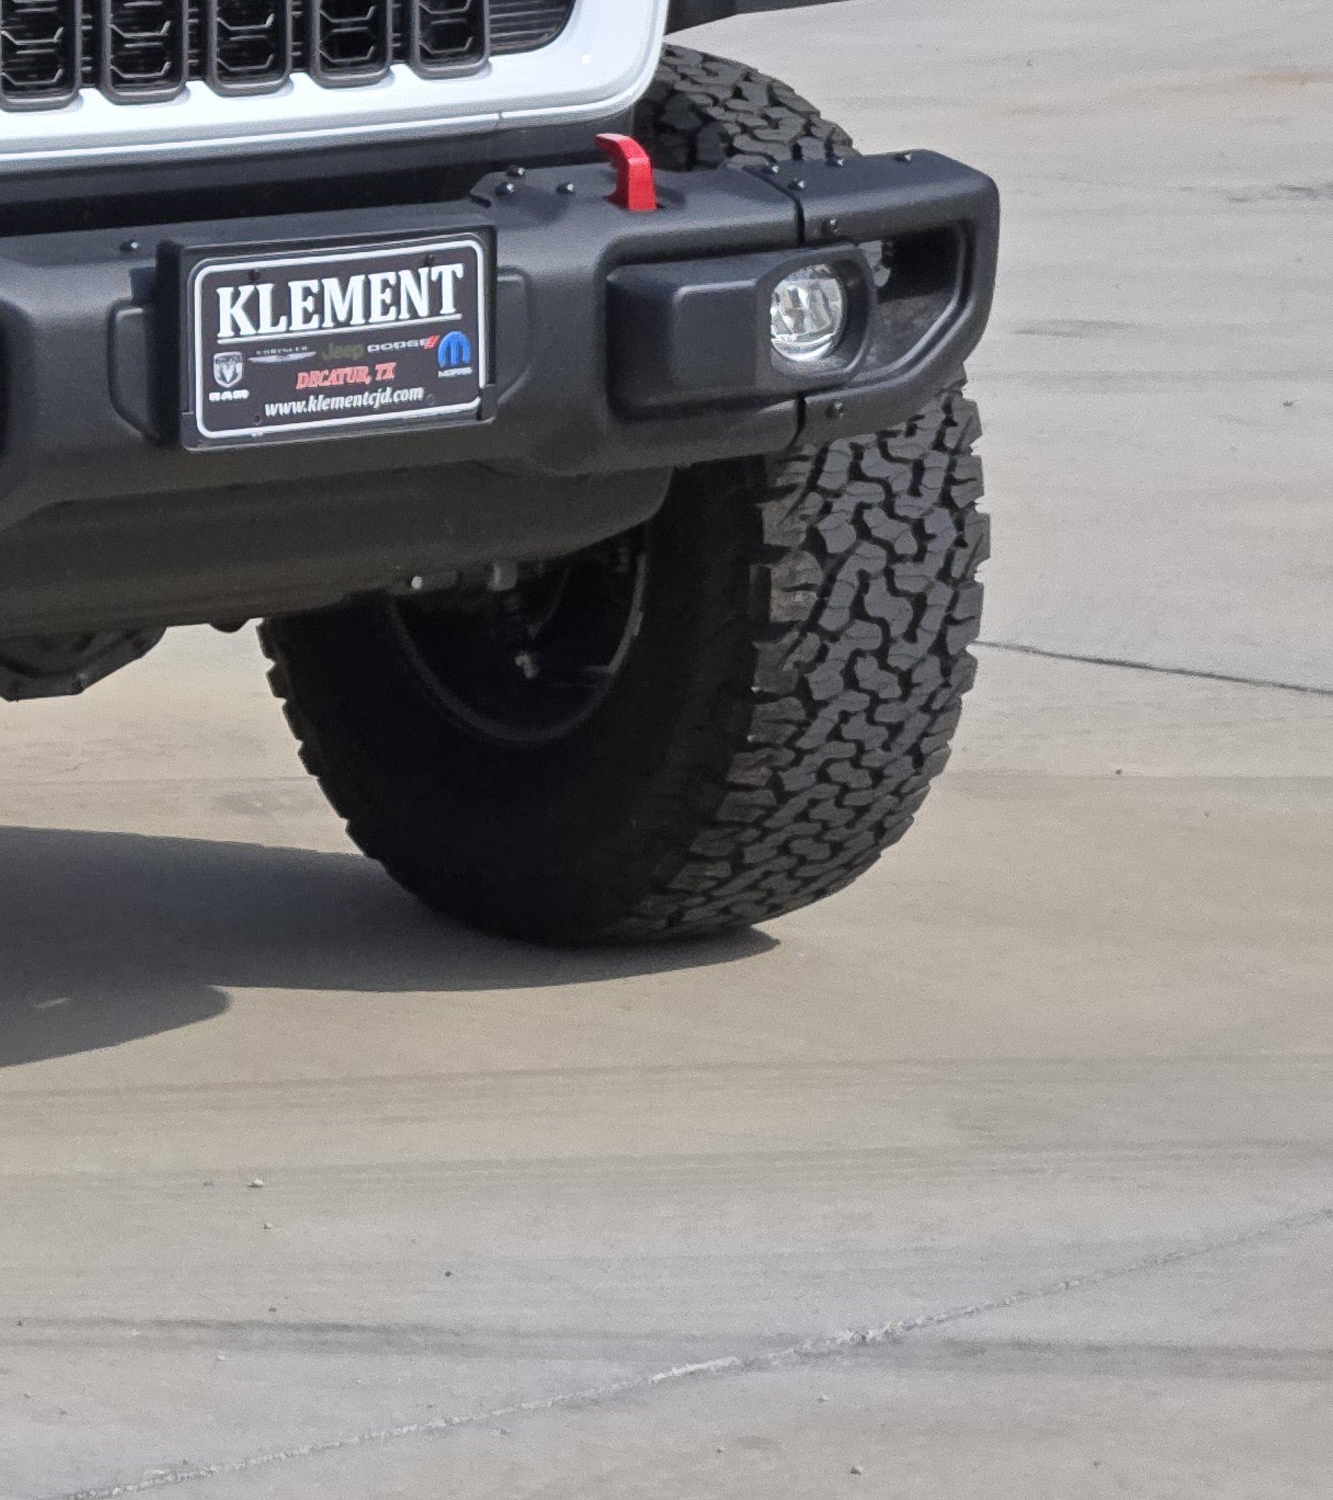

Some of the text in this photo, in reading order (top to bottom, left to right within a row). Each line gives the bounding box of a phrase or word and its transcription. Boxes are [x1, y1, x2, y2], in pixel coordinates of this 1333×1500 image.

[216, 263, 464, 338] KLEMENT
[321, 342, 365, 361] Jeep
[295, 362, 397, 390] DECATUR, TX
[264, 386, 425, 417] www.klementcjd.com
